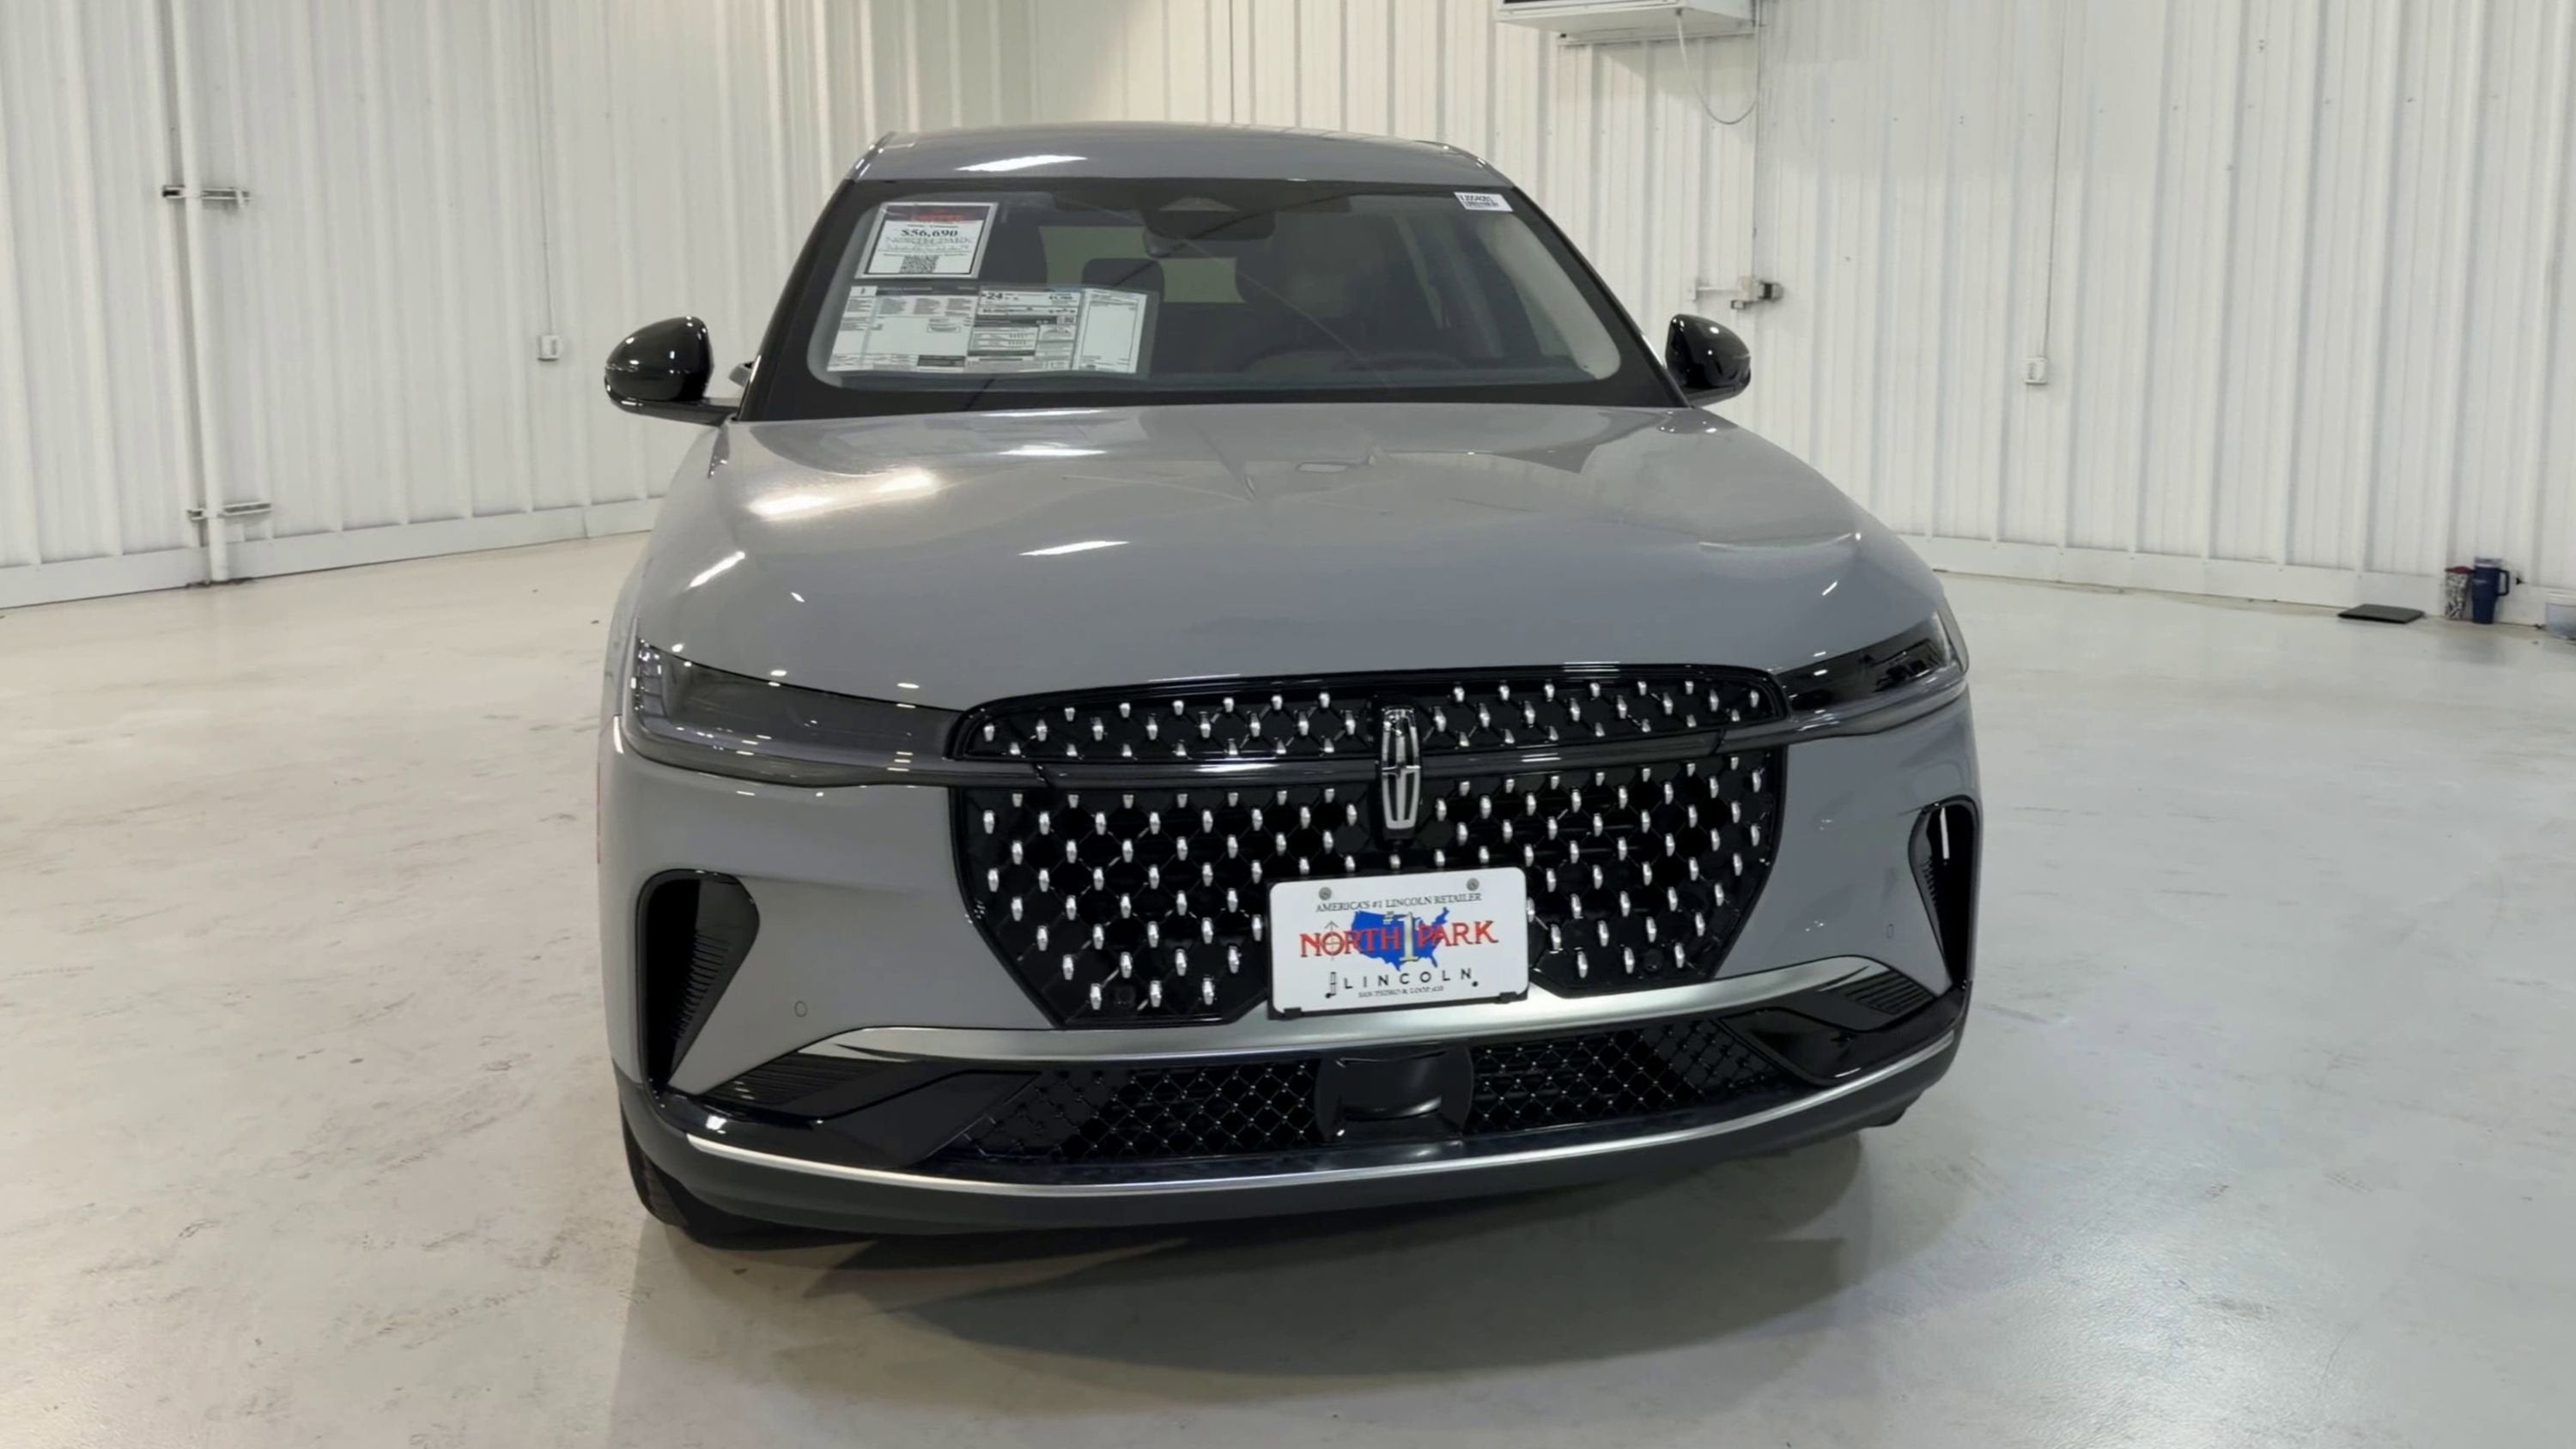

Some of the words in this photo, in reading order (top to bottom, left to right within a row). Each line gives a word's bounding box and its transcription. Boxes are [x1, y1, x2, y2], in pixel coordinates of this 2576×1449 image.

[1315, 900, 1370, 912] AMERICA'S
[1385, 895, 1432, 908] LINCOLN
[1434, 893, 1482, 904] RETAILER
[1300, 925, 1401, 958] NORTH
[1417, 919, 1499, 948] PARK
[1344, 968, 1472, 989] LINCOLN
